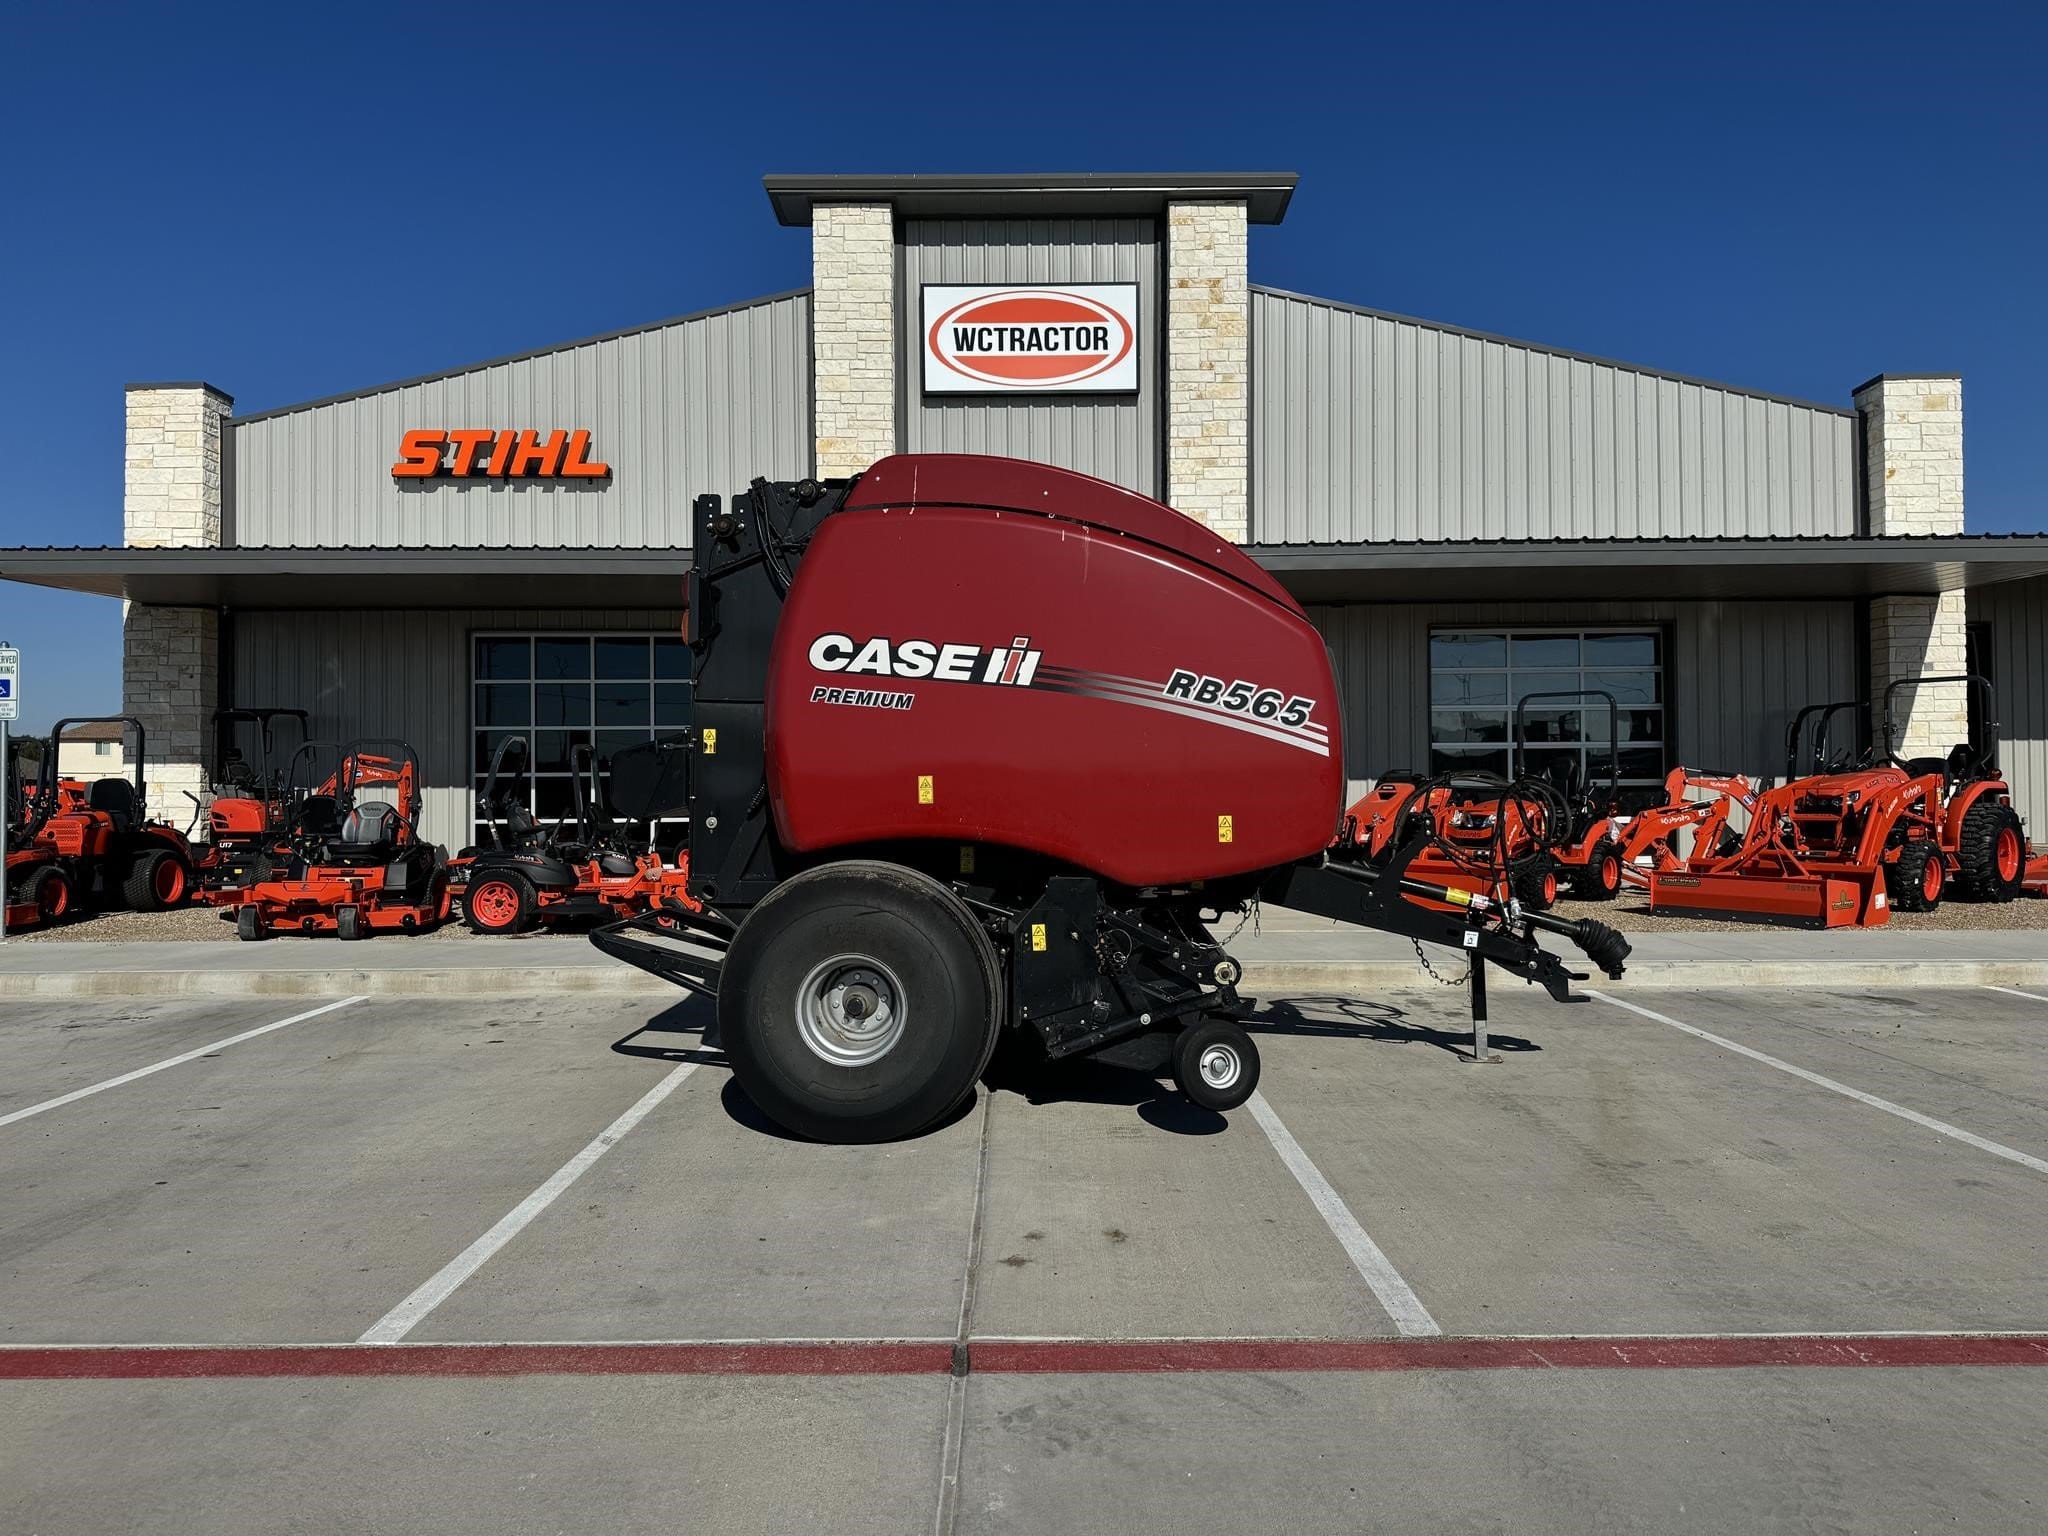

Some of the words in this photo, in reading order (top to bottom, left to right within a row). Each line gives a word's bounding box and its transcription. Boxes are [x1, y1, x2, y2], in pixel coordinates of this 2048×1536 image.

[953, 326, 1109, 352] WCTRACTOR
[391, 429, 610, 477] STIHL
[808, 634, 981, 681] CASE
[810, 686, 915, 710] PREMIUM
[1162, 668, 1316, 728] RB565
[1660, 814, 1691, 825] Kubota
